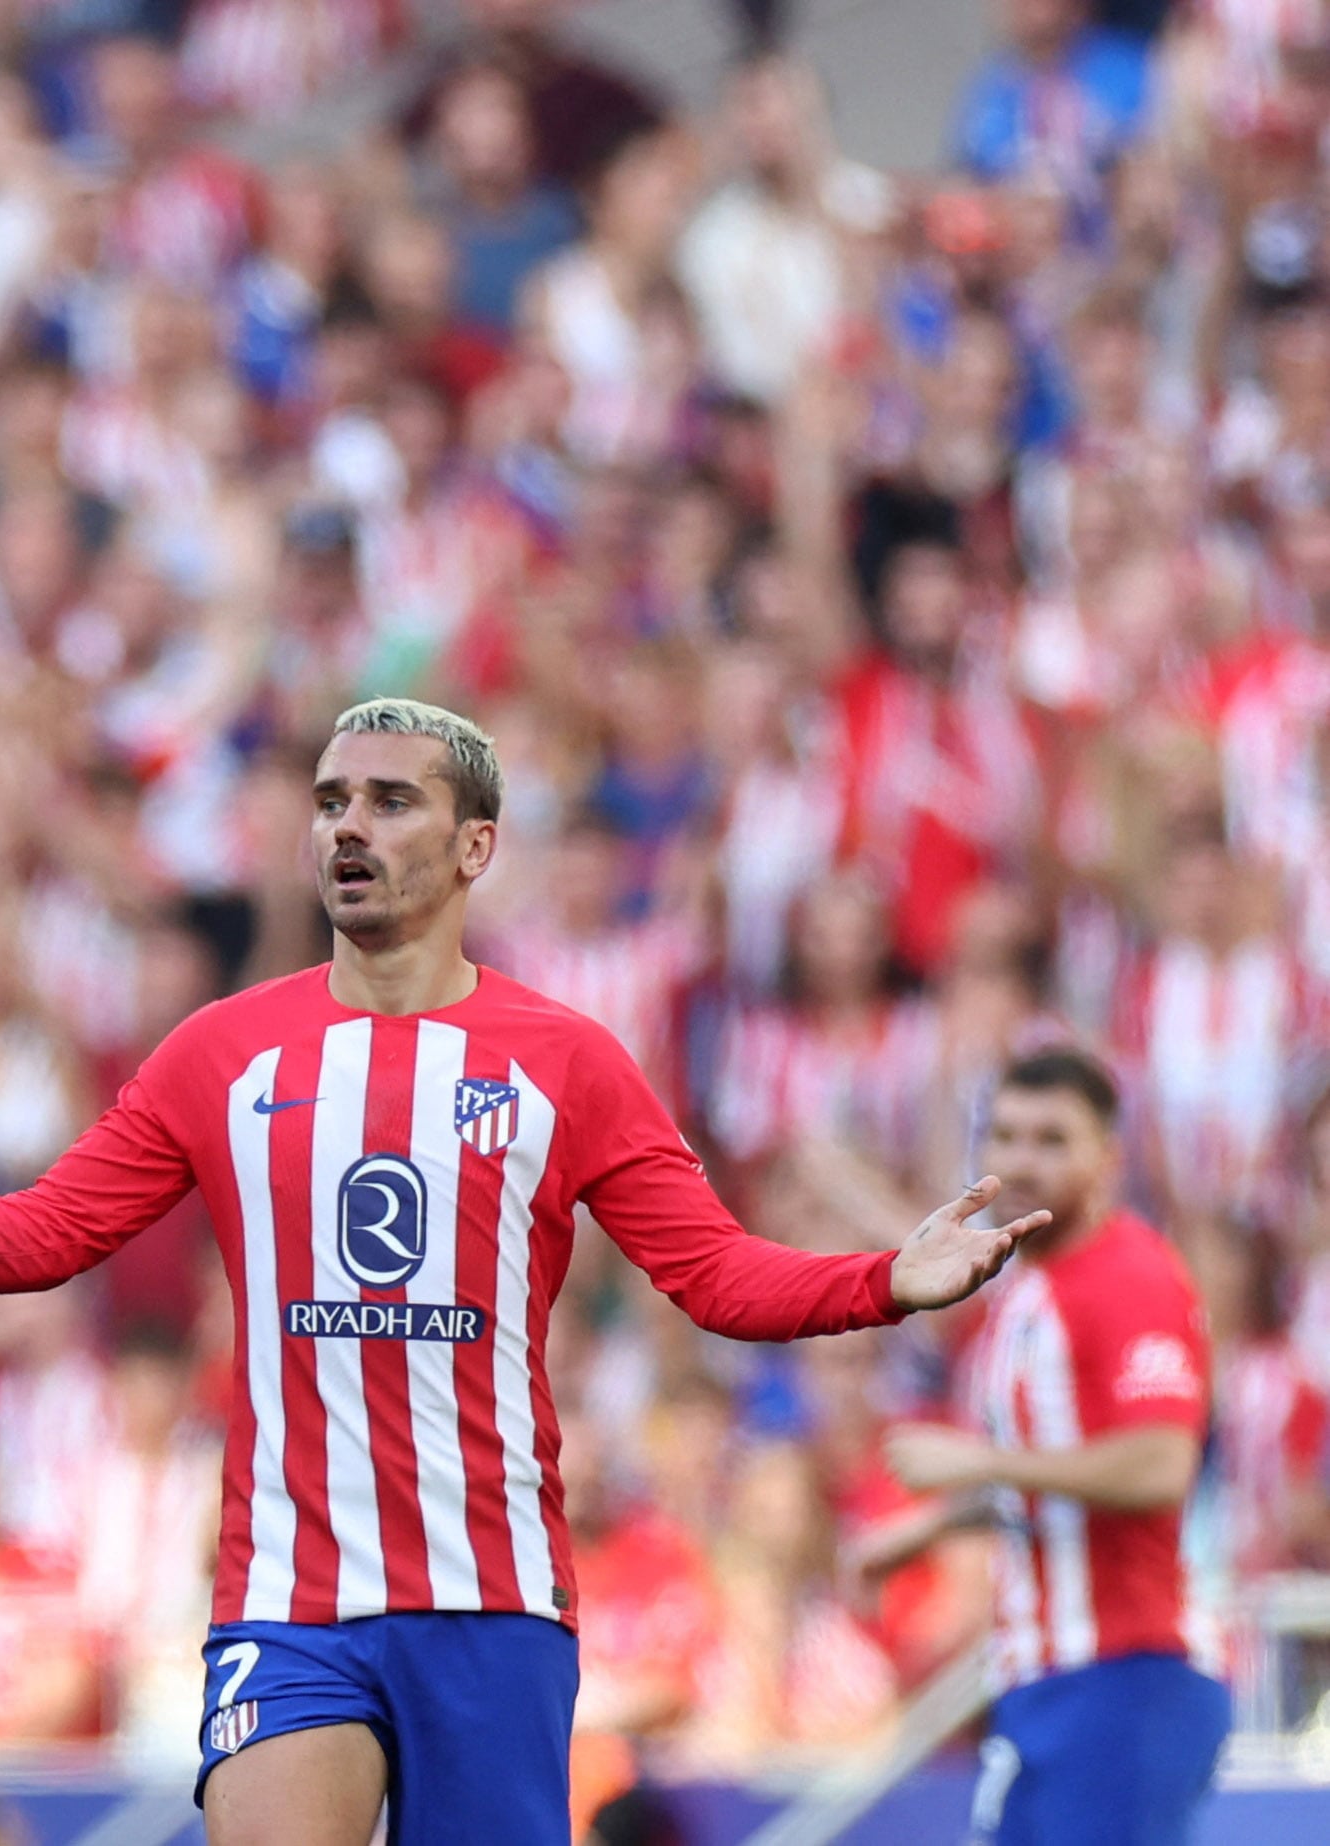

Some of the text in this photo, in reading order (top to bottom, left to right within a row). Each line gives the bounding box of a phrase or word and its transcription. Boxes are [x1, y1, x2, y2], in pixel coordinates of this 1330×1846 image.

[290, 1305, 477, 1339] RIYADH AIR
[217, 1641, 261, 1708] 7
